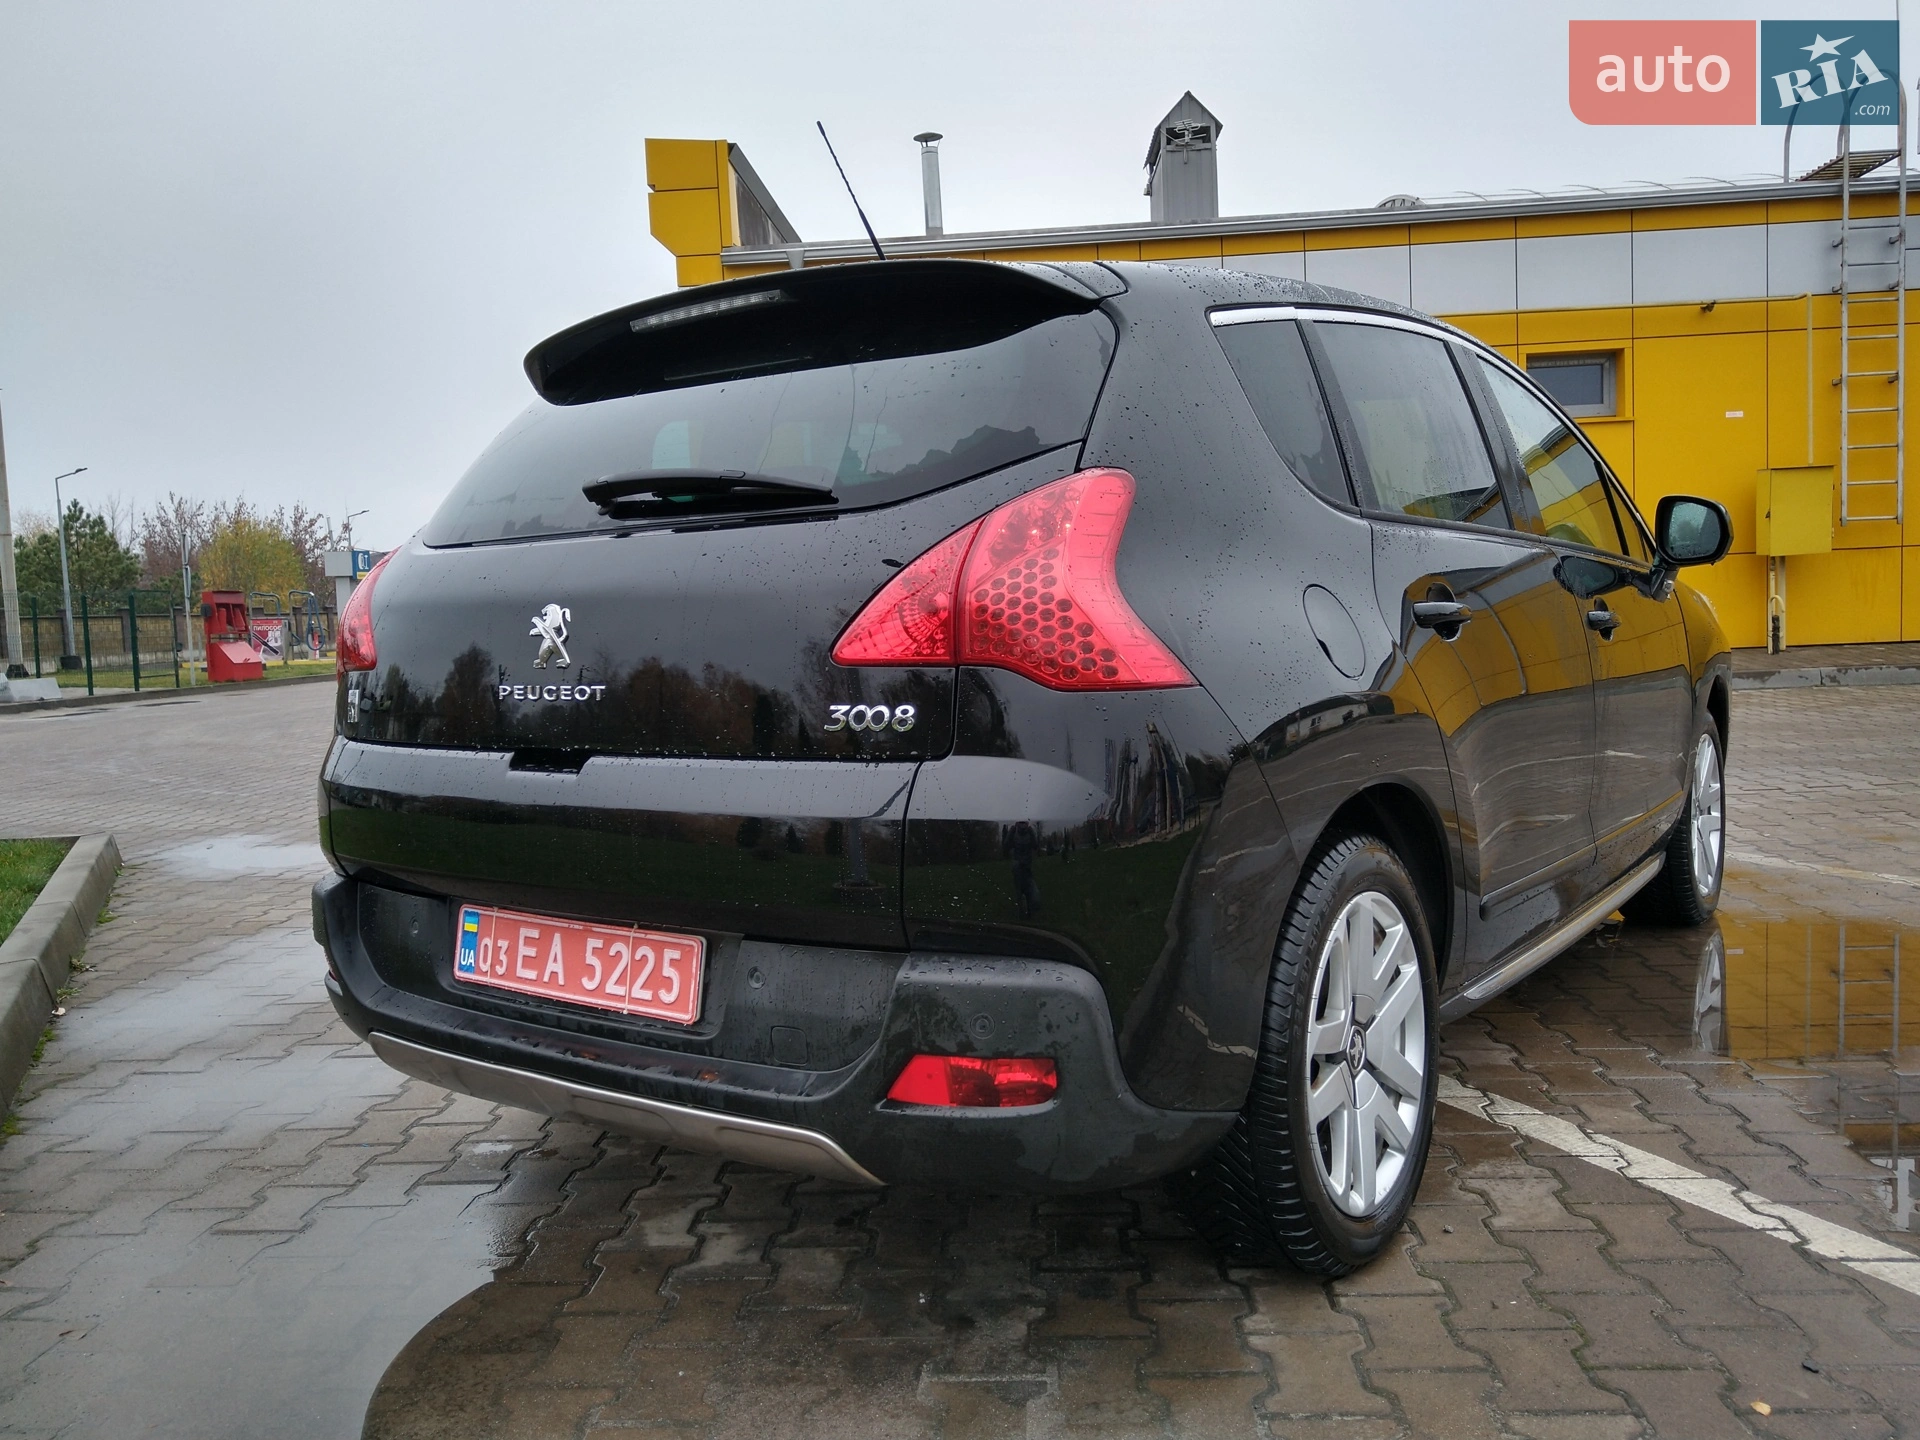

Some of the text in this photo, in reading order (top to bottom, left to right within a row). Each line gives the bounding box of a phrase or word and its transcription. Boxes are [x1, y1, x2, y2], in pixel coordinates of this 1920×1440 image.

[498, 685, 606, 701] PEUGEOT
[823, 704, 915, 732] 3008
[460, 947, 475, 967] UA
[479, 926, 682, 1005] 03 EA 5225
